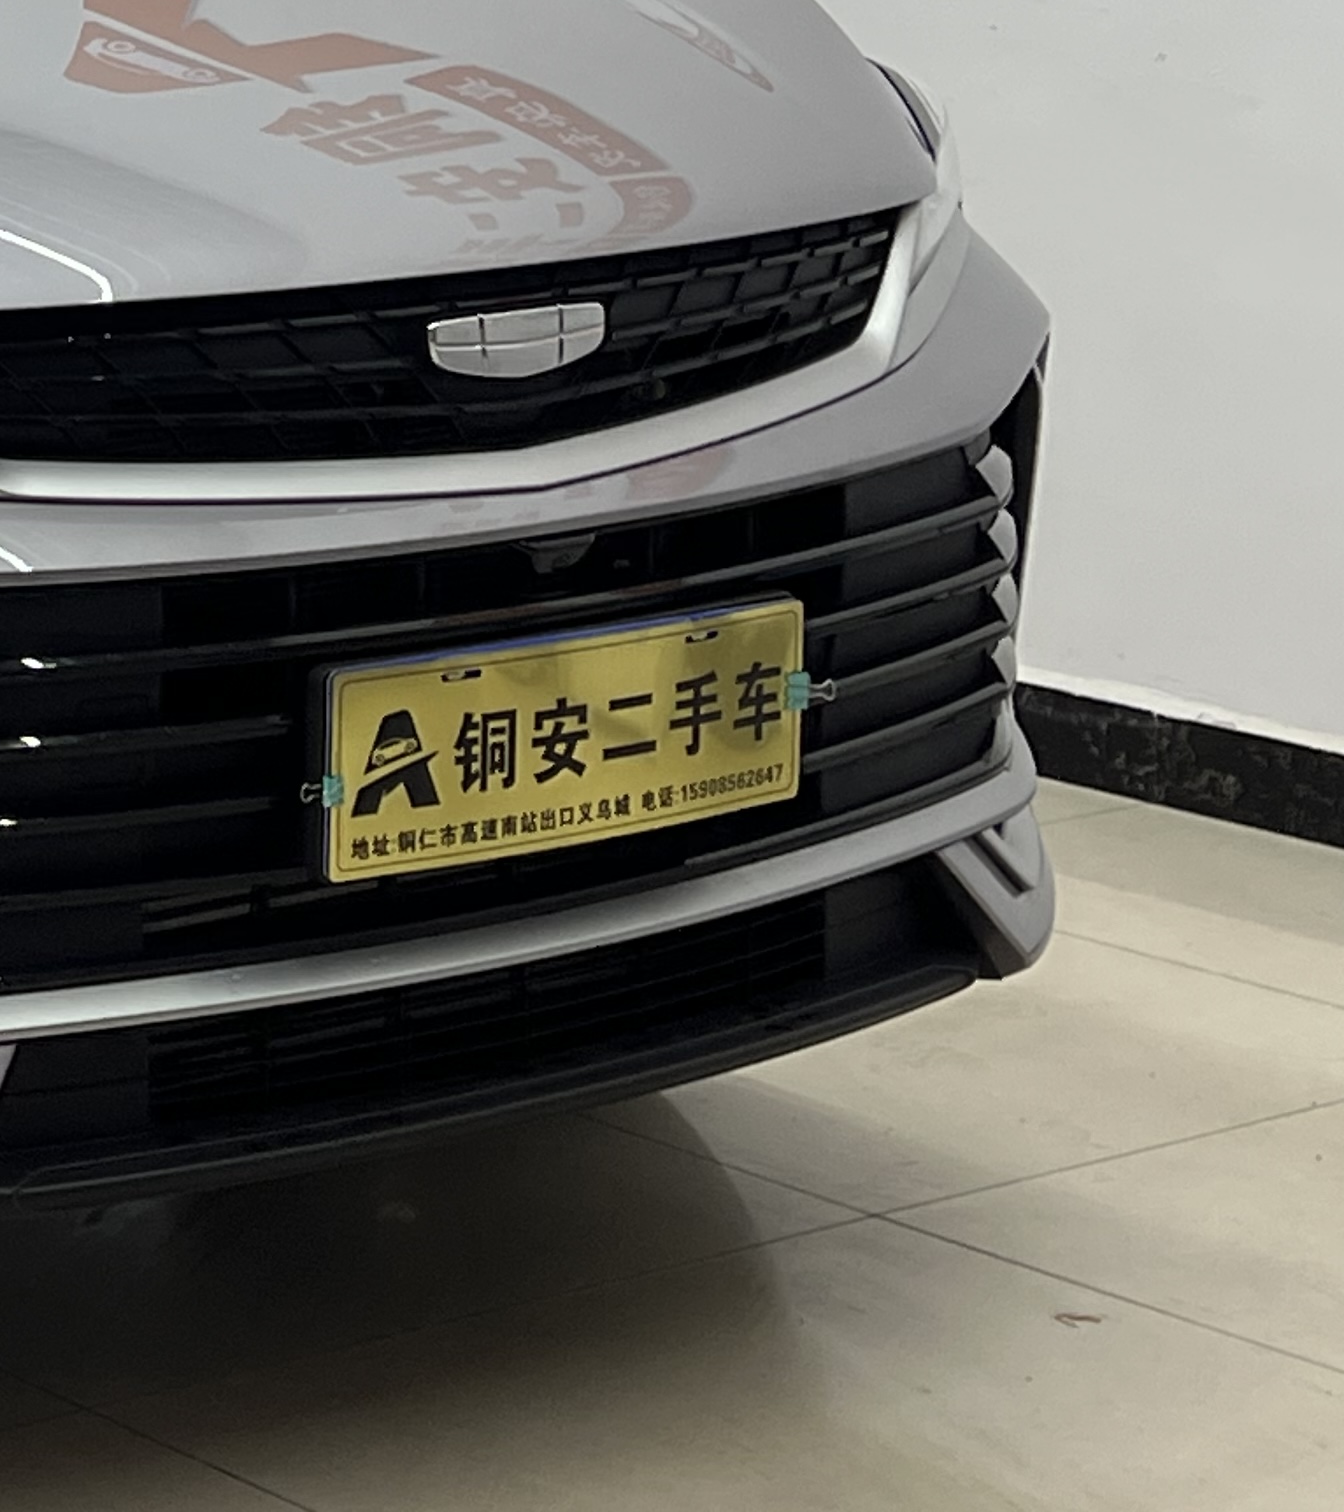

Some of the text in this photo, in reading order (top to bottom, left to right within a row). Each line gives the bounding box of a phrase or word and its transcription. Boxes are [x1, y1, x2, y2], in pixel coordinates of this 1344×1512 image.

[454, 661, 782, 793] 铜安二手车
